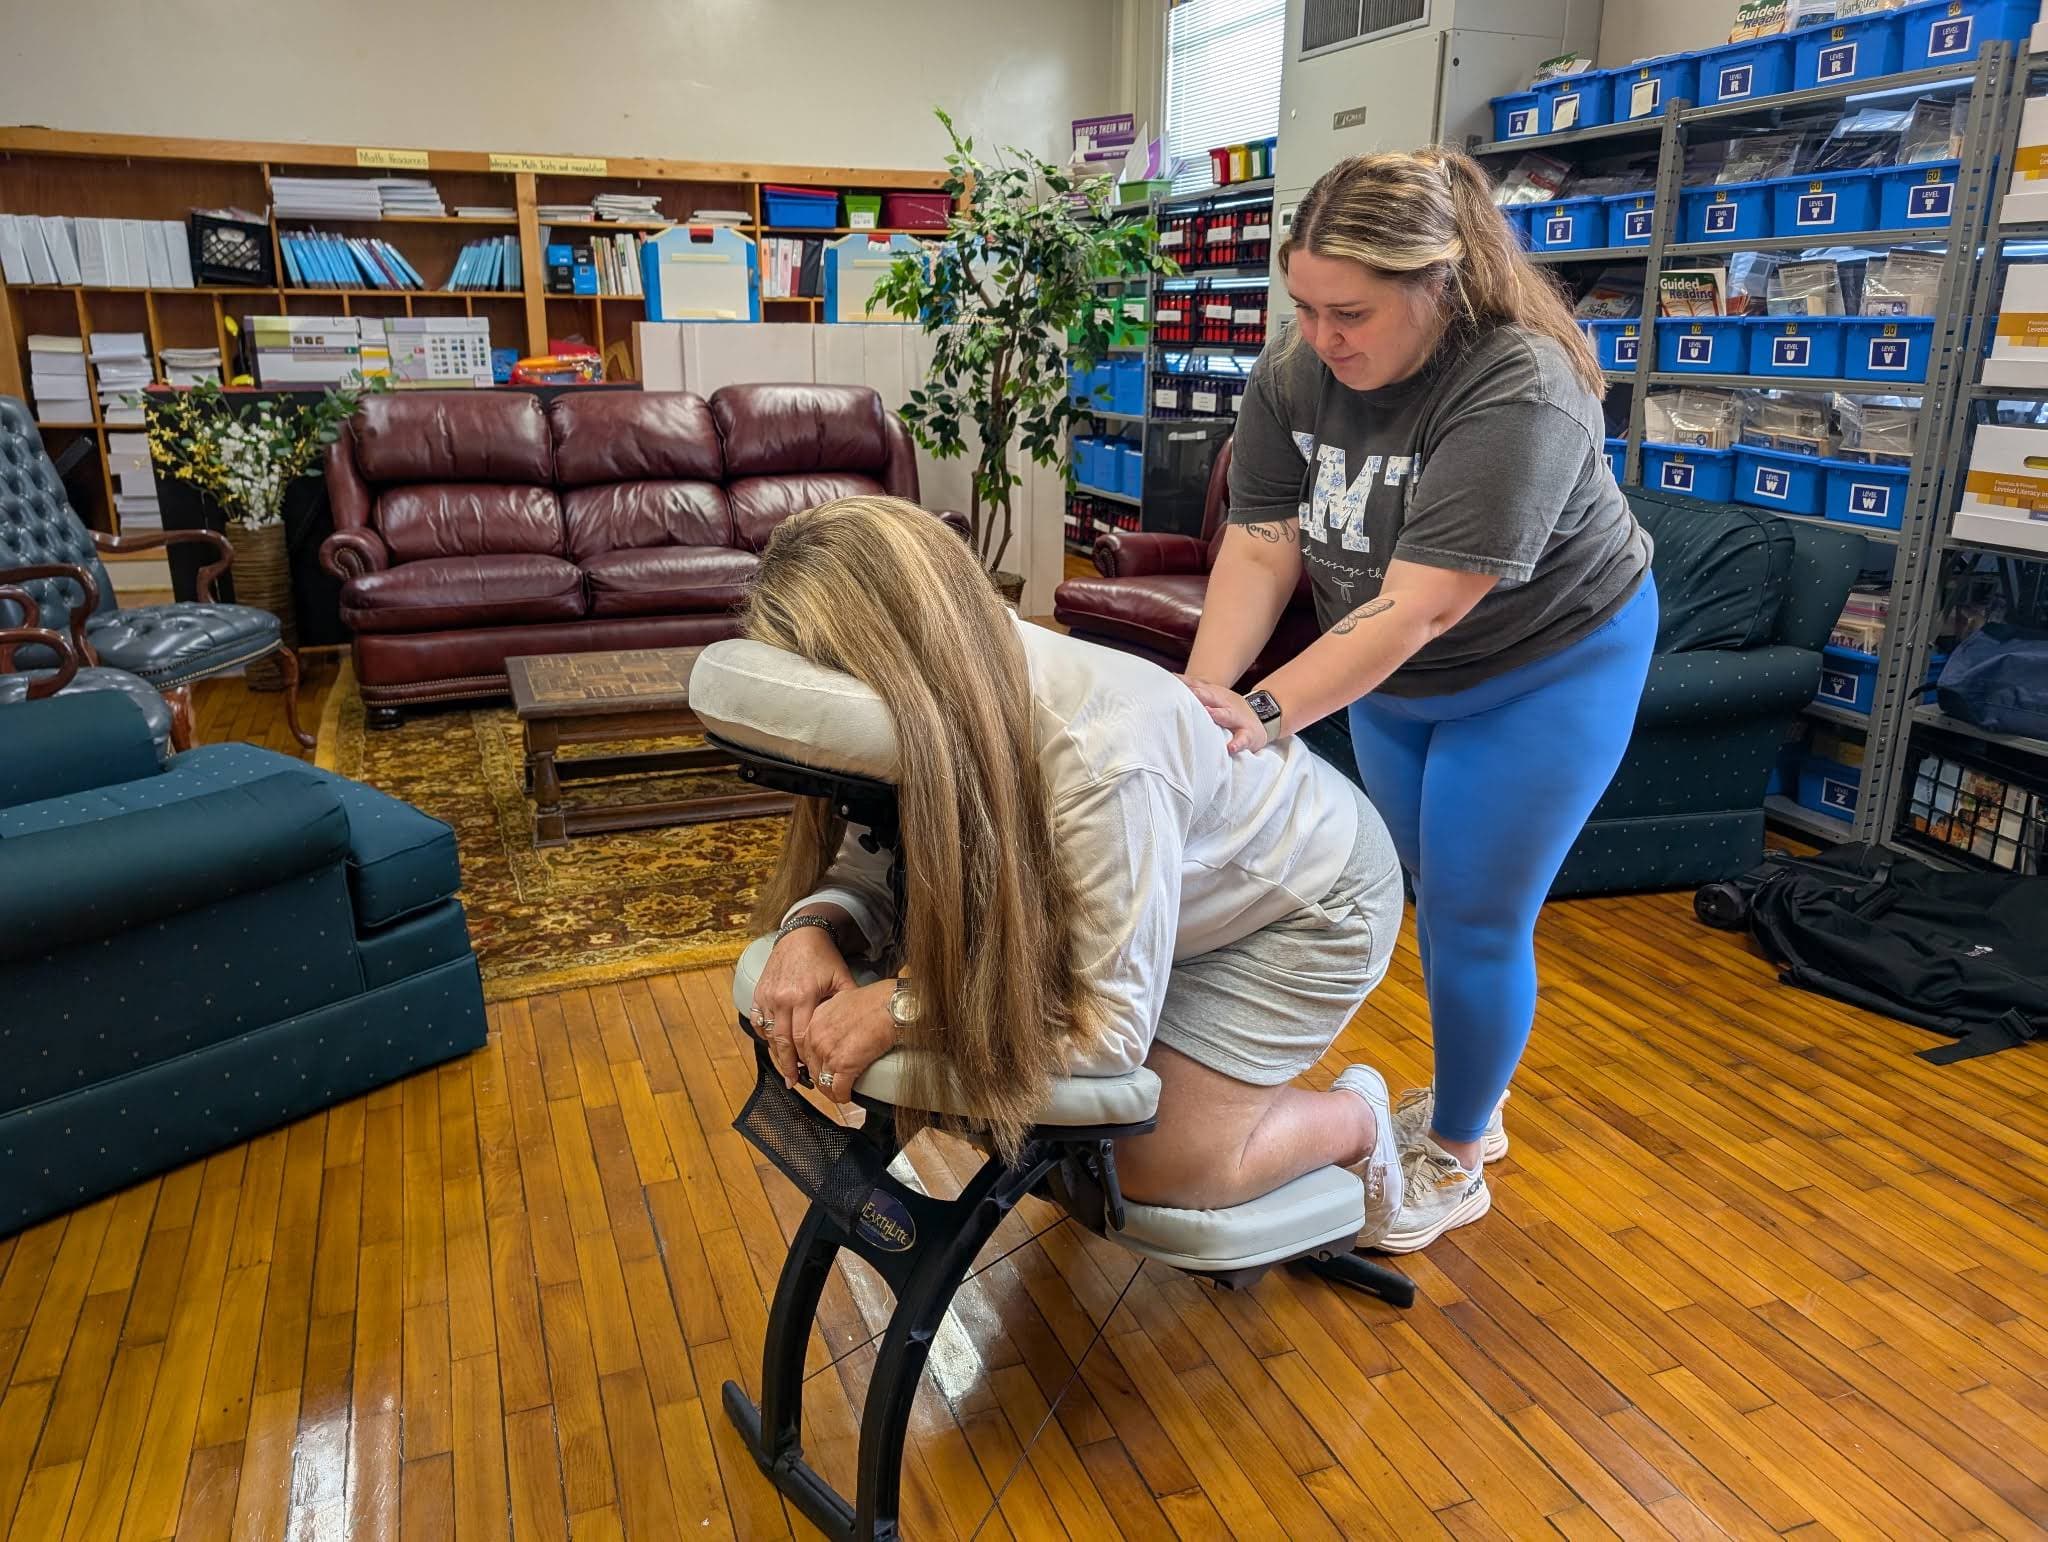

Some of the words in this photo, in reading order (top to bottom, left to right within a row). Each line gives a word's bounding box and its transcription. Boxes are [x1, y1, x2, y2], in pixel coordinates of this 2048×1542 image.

[1737, 0, 1785, 22] Guided
[1943, 26, 1959, 35] LEVEL
[1944, 35, 1954, 48] S
[1830, 53, 1845, 61] LEVEL
[1831, 61, 1841, 73] R
[1729, 73, 1742, 81] LEVEL
[1730, 81, 1739, 92] R
[1075, 126, 1098, 137] WORDS
[1099, 122, 1117, 134] THEIR
[1118, 120, 1132, 132] WAY
[1922, 190, 1940, 199] LEVEL
[1809, 200, 1825, 208] LEVEL
[1924, 198, 1935, 210] T
[1811, 207, 1821, 219] T
[1716, 216, 1724, 227] S
[1660, 278, 1699, 290] Guided
[1690, 348, 1699, 358] U
[1786, 350, 1796, 361] U
[1883, 352, 1894, 364] V
[1671, 468, 1685, 476] LEVEL
[1766, 473, 1779, 482] LEVEL
[1766, 480, 1778, 492] W
[1861, 490, 1878, 499] LEVEL
[1862, 497, 1877, 510] W
